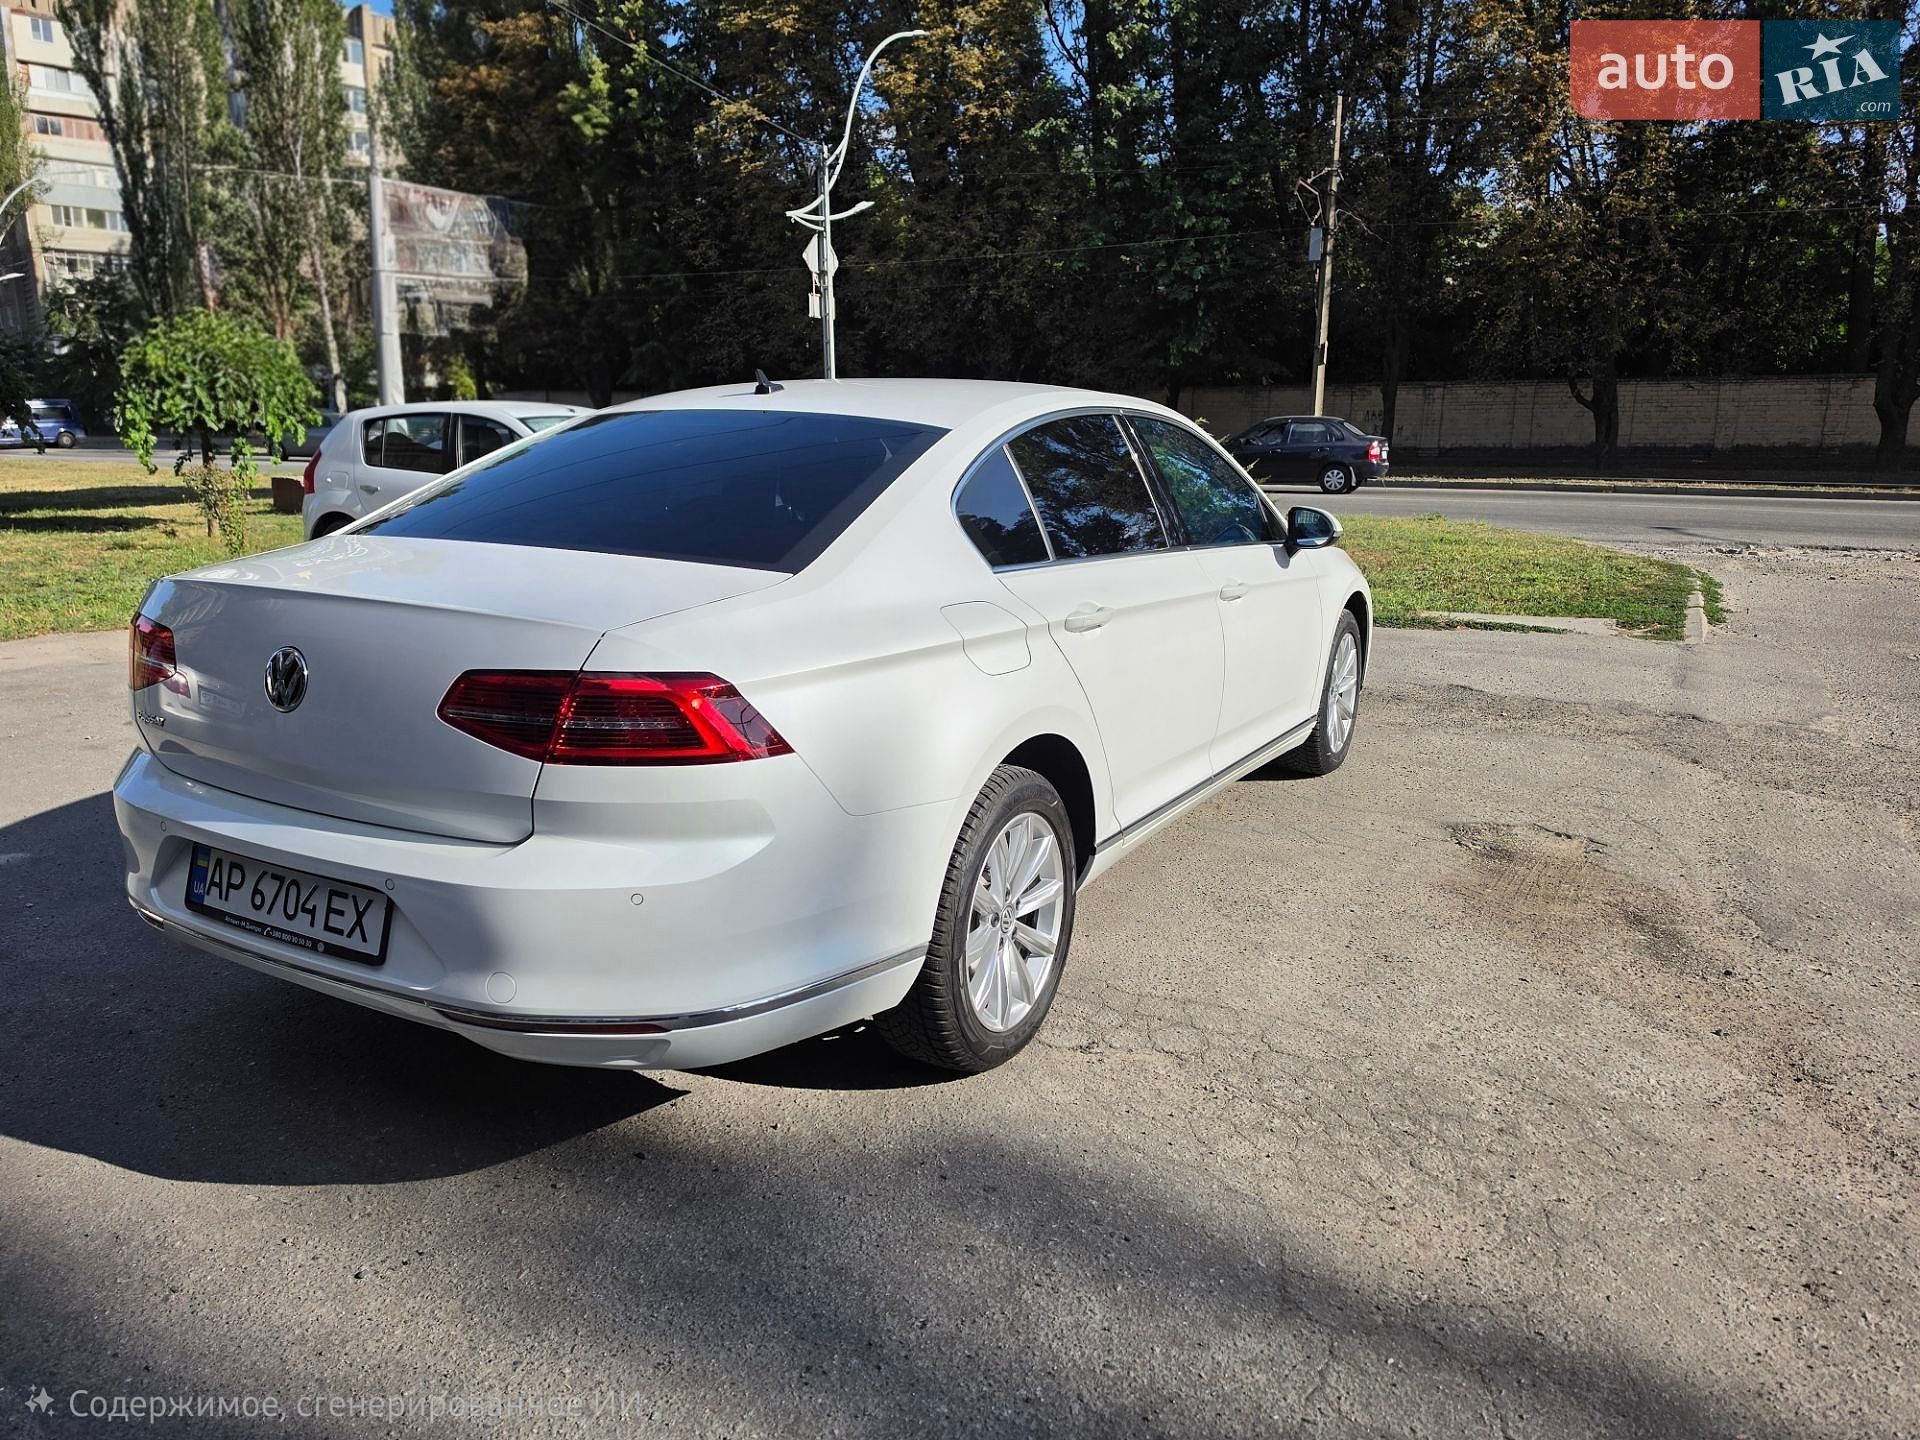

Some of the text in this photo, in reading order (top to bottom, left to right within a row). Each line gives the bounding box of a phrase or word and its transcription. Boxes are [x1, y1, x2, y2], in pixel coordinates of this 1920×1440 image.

[193, 882, 204, 895] UA
[206, 858, 374, 943] AP 6704 EX
